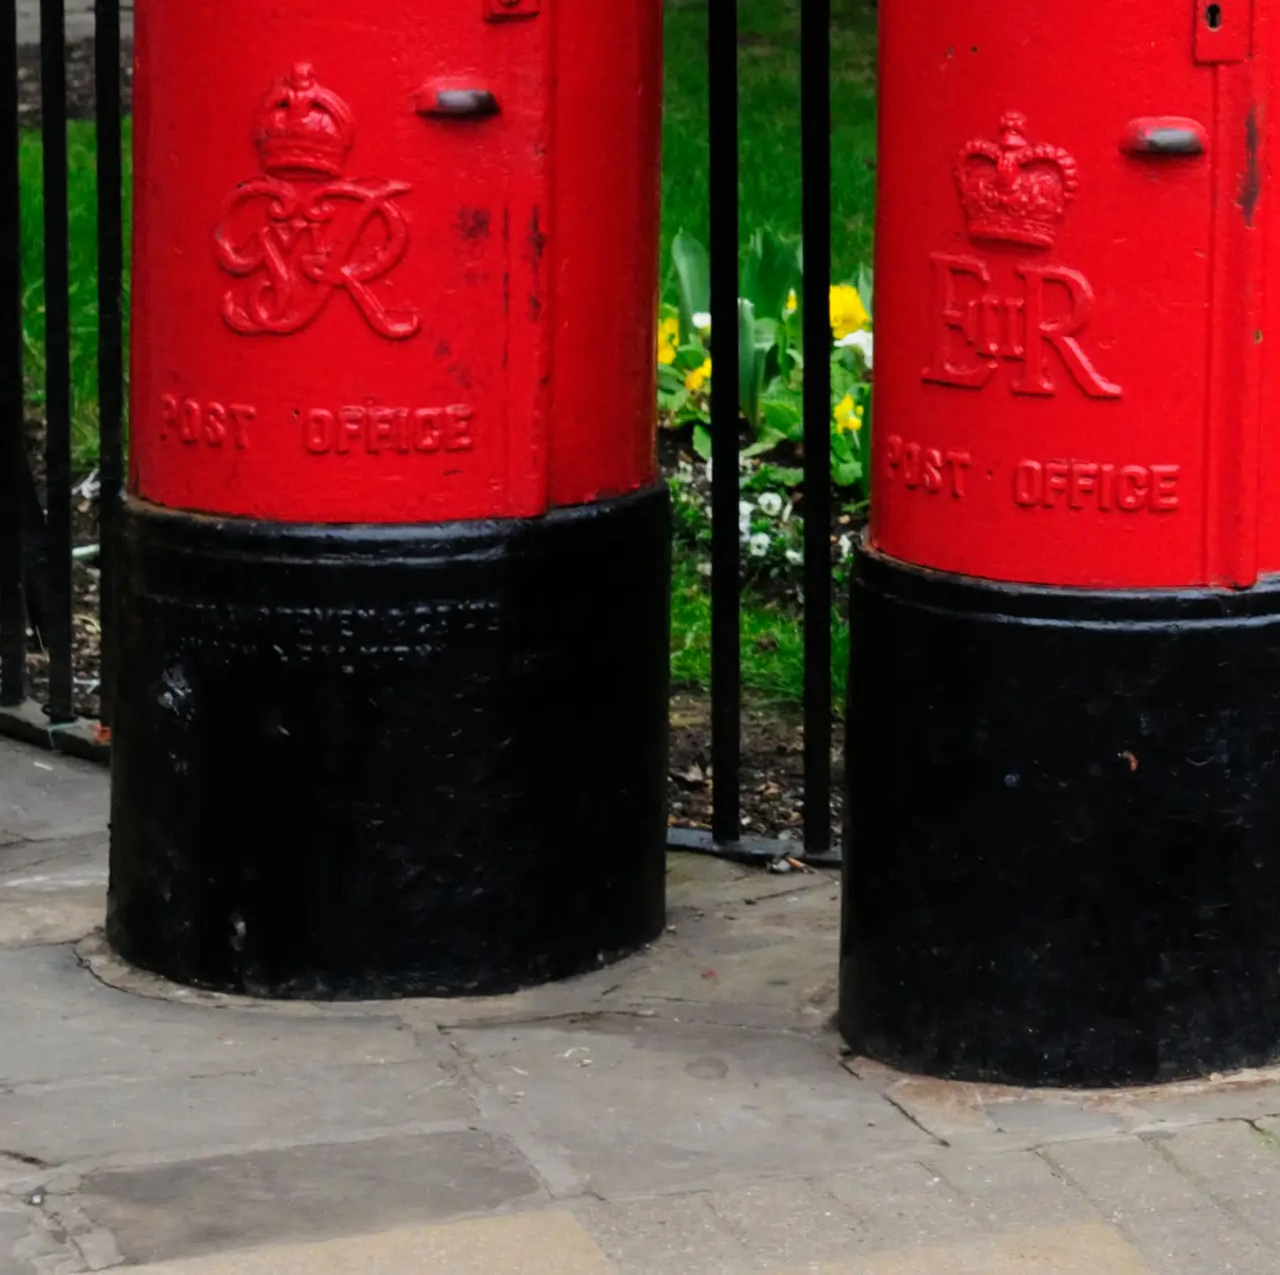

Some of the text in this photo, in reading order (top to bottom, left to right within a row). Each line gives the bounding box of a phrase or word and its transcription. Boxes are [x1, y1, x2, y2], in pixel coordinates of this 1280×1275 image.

[160, 393, 474, 456] POST OFFICE
[885, 435, 1180, 513] POST OFFICE
